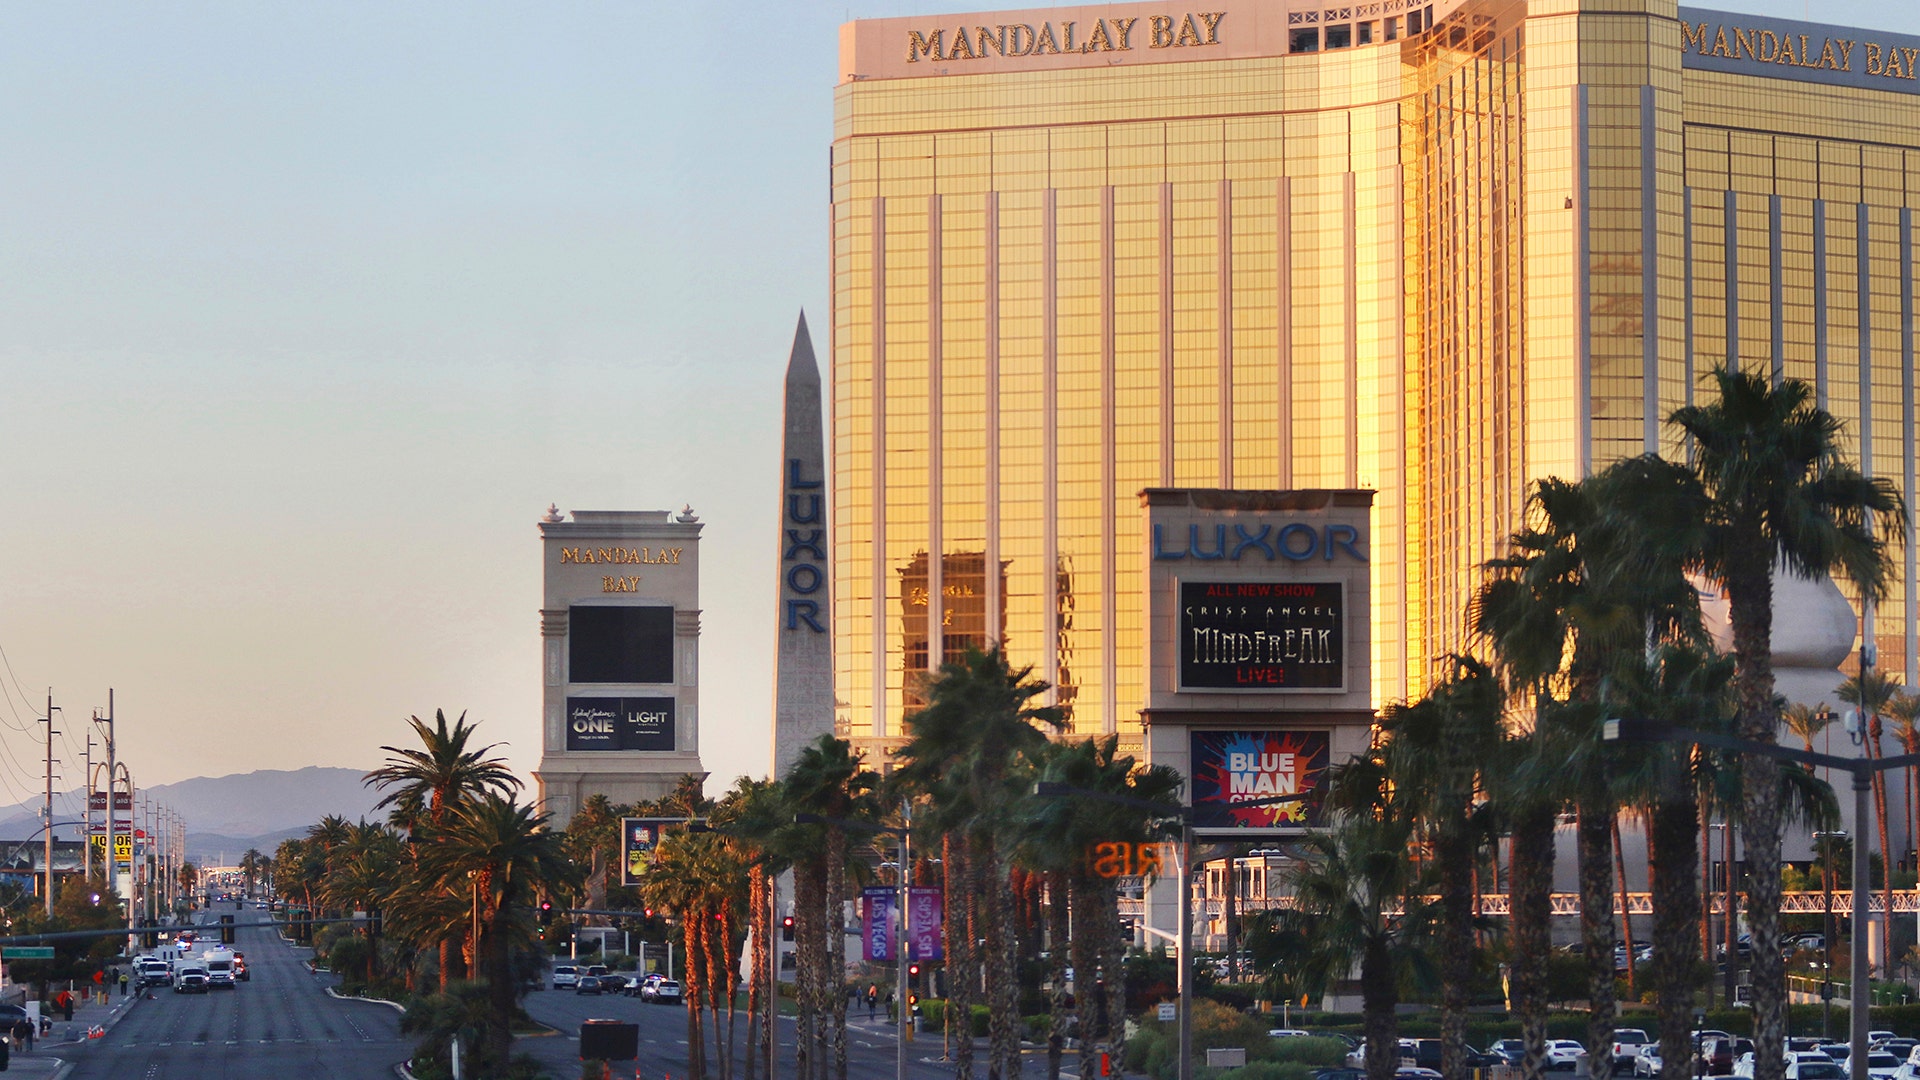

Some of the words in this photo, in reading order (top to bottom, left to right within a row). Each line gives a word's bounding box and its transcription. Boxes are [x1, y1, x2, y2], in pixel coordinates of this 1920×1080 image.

[906, 17, 1137, 63] MANDALAY
[1149, 12, 1227, 49] BAY
[1681, 20, 1855, 71] MANDALAY
[1865, 42, 1920, 80] BAY
[785, 459, 826, 633] LUXOR
[1153, 523, 1369, 561] LUXOR
[560, 547, 683, 564] MANDALAY
[602, 575, 641, 592] BAY
[1206, 585, 1233, 597] ALL
[1237, 585, 1270, 597] NEW
[1274, 585, 1316, 597] SHOW
[1186, 606, 1247, 617] CRISS
[1266, 606, 1336, 617] ANGEL
[1237, 667, 1285, 683] LIVE!
[573, 719, 614, 733] ONE
[628, 712, 667, 723] LIGHT
[1230, 753, 1295, 772] BLUE
[1230, 773, 1295, 794] MAN
[872, 896, 886, 918] LAS
[919, 896, 932, 933] VEGAS
[872, 920, 886, 957] VEGAS
[919, 935, 932, 957] LAS
